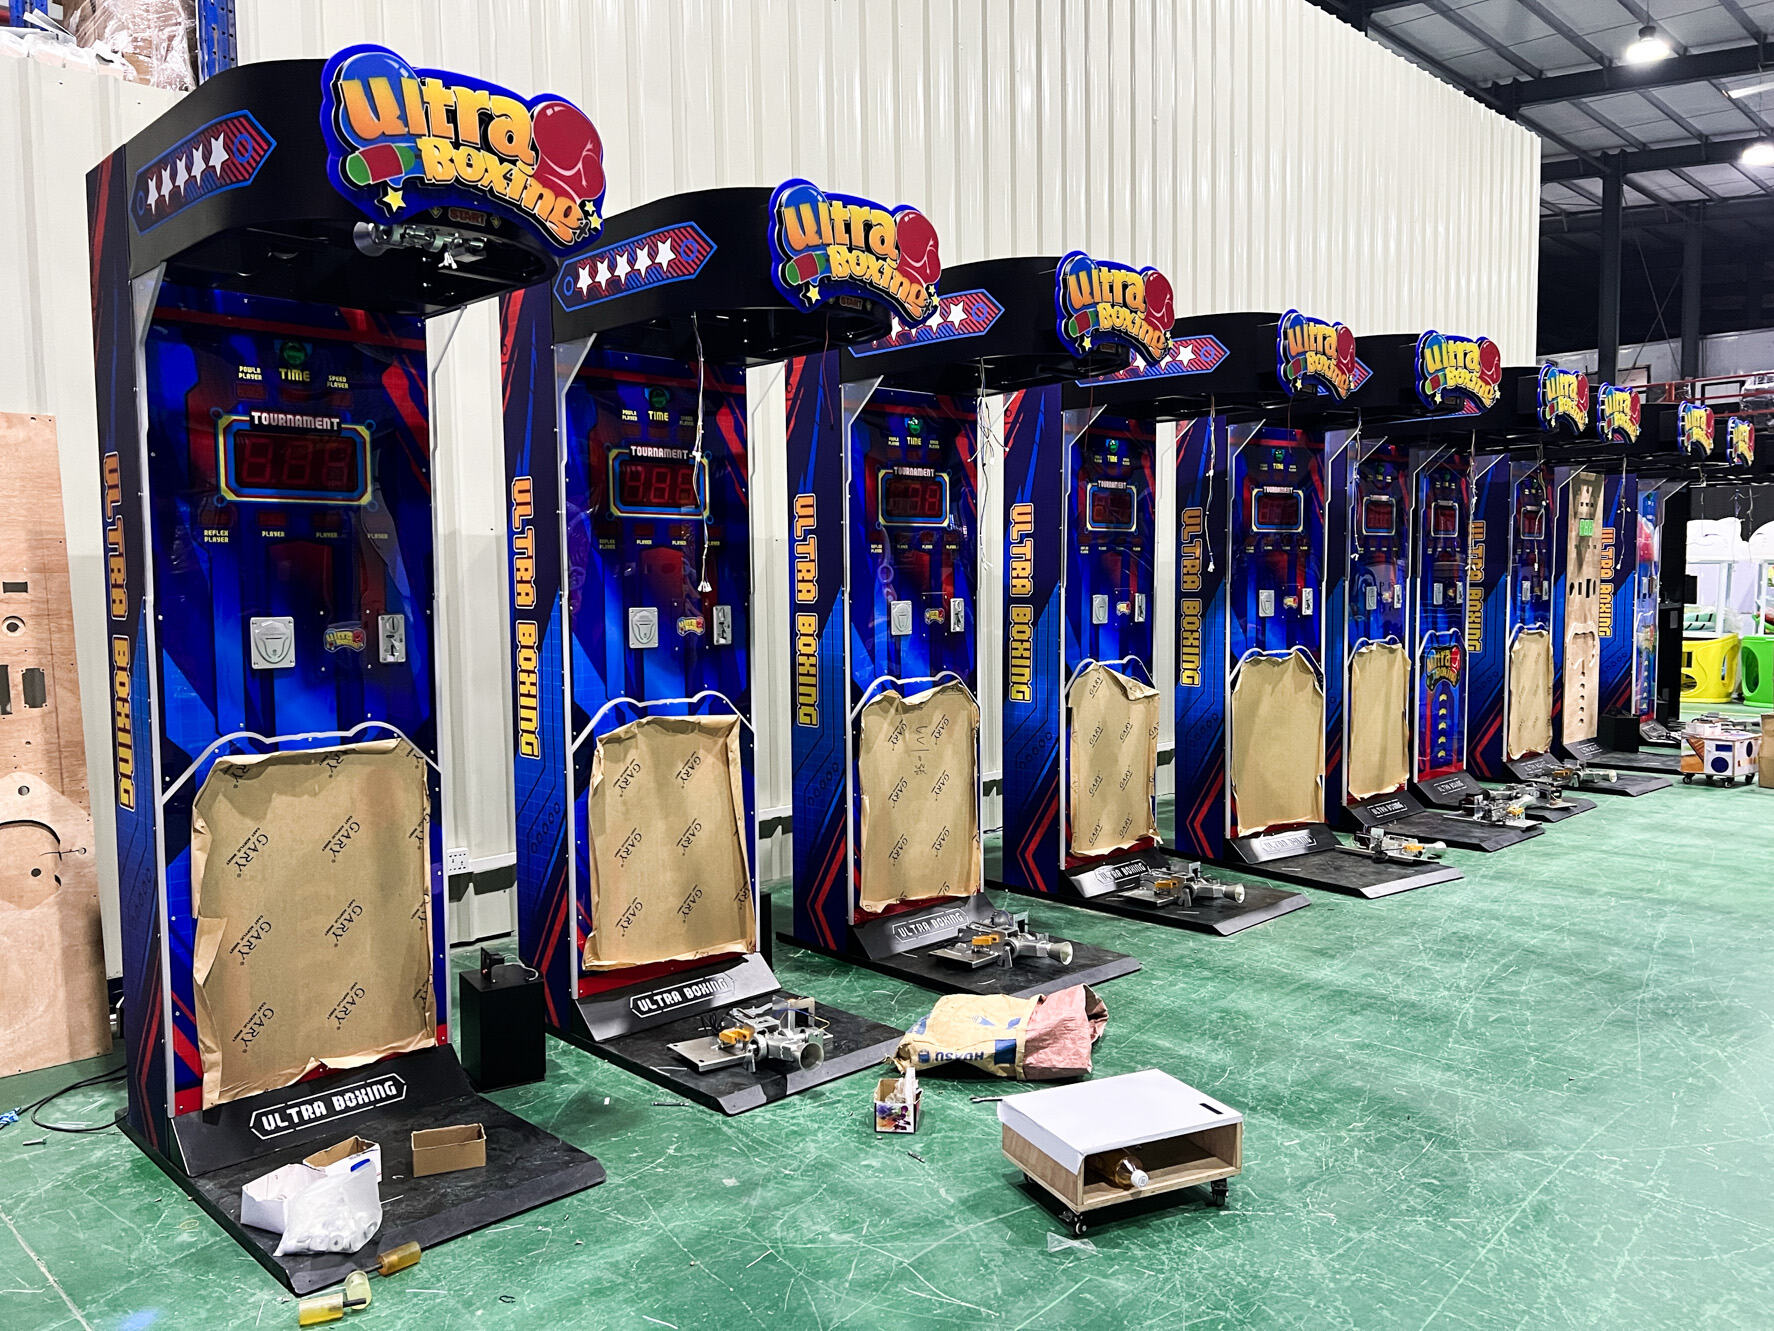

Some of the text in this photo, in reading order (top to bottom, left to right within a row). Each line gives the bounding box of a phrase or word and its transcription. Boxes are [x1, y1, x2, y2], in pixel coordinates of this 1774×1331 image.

[340, 76, 536, 165] Ultra
[416, 137, 587, 245] Boxing
[449, 208, 486, 225] START
[784, 199, 901, 262] Ultra
[827, 246, 930, 320] Boxing
[1069, 267, 1146, 312] Ultra
[1097, 302, 1167, 360] Boxing
[1287, 322, 1338, 359] Ultra
[1425, 340, 1480, 373] Ultra
[238, 372, 262, 380] PLAYER
[279, 367, 310, 382] TIME
[328, 374, 346, 382] SPEED
[1306, 351, 1350, 399] Boxing
[251, 411, 340, 430] TOURNAMENT
[648, 410, 669, 422] TIME
[630, 446, 688, 459] TOURNAMENT
[893, 466, 935, 477] TOURNAMENT
[204, 529, 229, 537] REFLEX
[204, 536, 229, 544] PLAYER
[262, 530, 285, 538] PLAYER
[794, 494, 819, 728] ULTRA BOXING
[1009, 502, 1034, 703] ULTRA BOXING
[1180, 507, 1202, 687] ULTRA BOXING
[1598, 582, 1614, 638] BOXING
[104, 452, 135, 811] ULTRA BOXING
[512, 476, 541, 759] ULTRA BOXING
[891, 723, 907, 747] GARY
[934, 719, 950, 743] GARY
[617, 764, 641, 793] GARY
[680, 756, 701, 786] GARY
[934, 774, 949, 799] GARY
[892, 781, 907, 805] GARY
[234, 834, 268, 872] GARY
[329, 822, 360, 858] GARY
[619, 833, 642, 864] GARY
[680, 823, 702, 853] GARY
[892, 838, 908, 863] GARY
[934, 830, 950, 856] GARY
[1121, 862, 1146, 876] BOXING
[620, 902, 643, 934] GARY
[682, 890, 702, 921] GARY
[332, 906, 362, 943] GARY
[898, 912, 963, 937] ULTRA BOXING
[238, 922, 271, 960] GARY
[335, 988, 365, 1026] GARY
[637, 978, 728, 1012] ULTRA BOXING
[240, 1008, 274, 1048] GARY
[262, 1081, 397, 1131] ULTRA BOXING
